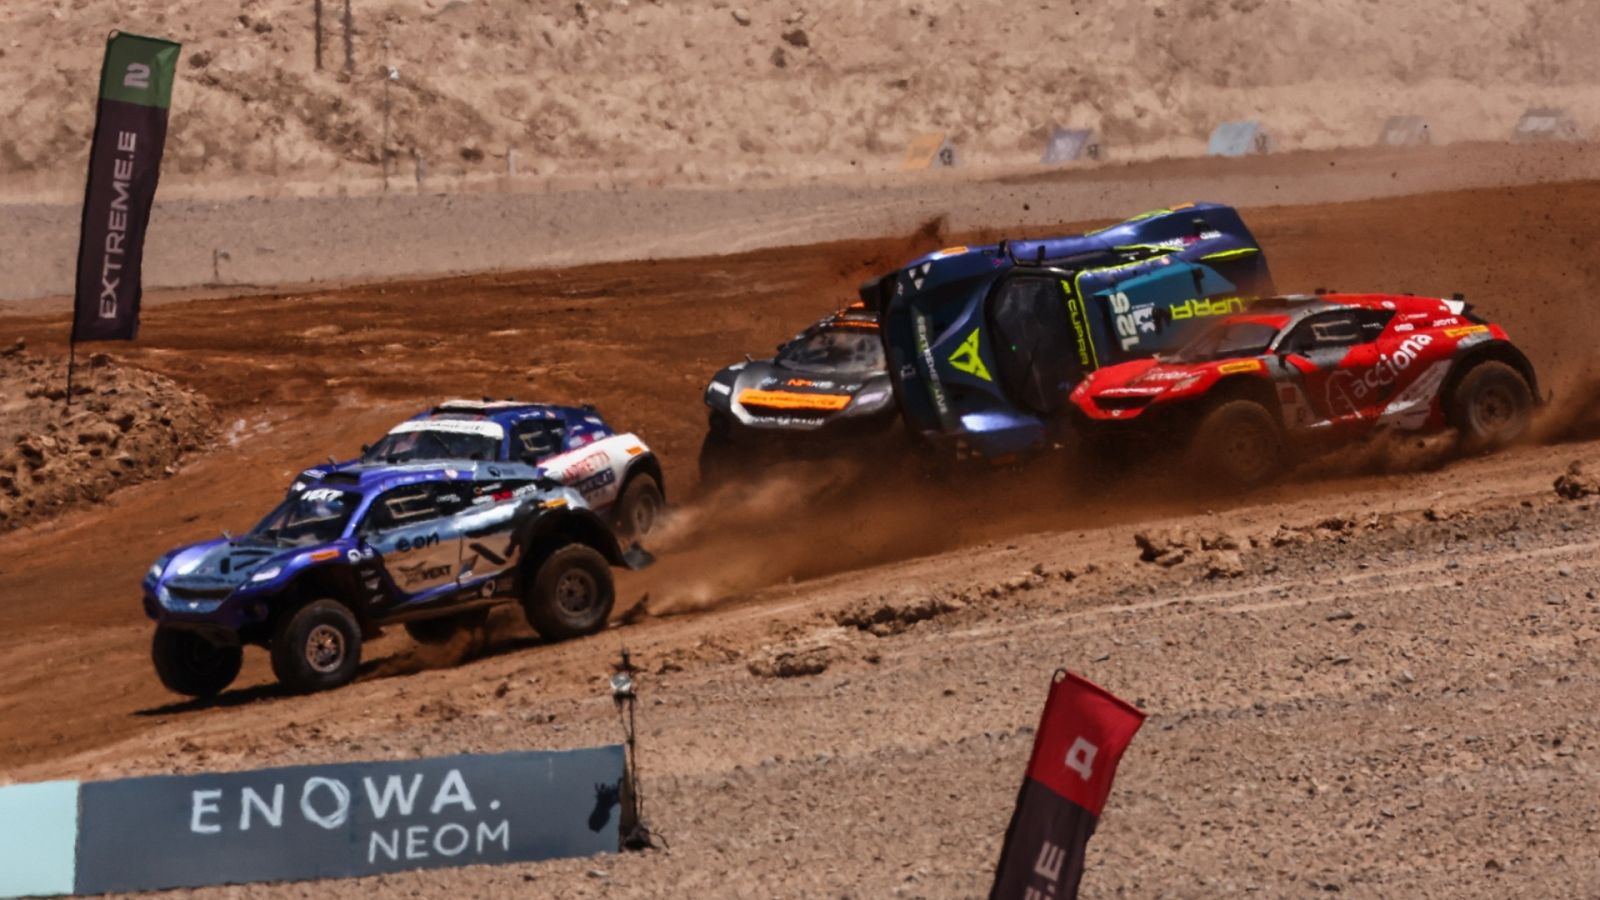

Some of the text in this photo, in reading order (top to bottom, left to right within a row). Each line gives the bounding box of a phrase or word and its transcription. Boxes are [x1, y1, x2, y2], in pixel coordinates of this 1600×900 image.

[123, 62, 151, 89] 2
[1067, 299, 1089, 366] CUPRA
[1109, 291, 1139, 352] 125
[1350, 334, 1433, 399] acciona
[368, 820, 509, 863] NEOM
